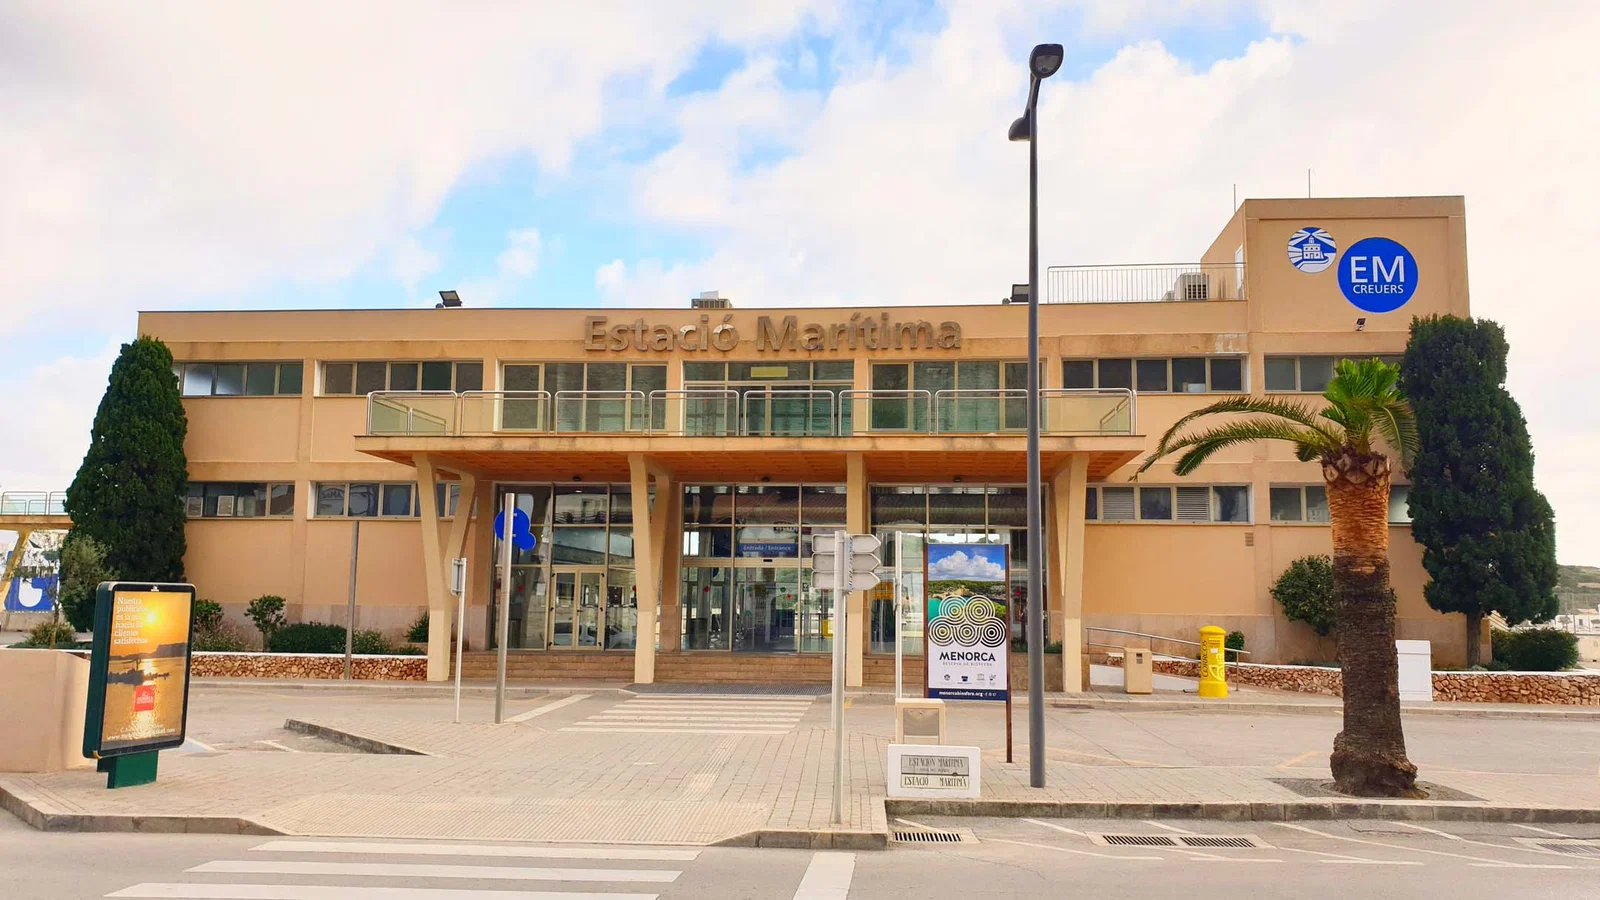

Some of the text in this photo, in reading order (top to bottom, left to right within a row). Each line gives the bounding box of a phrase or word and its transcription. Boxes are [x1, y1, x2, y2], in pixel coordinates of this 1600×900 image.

[1350, 255, 1405, 283] EM
[1352, 284, 1404, 294] CREUERS
[584, 312, 962, 352] Estació Marítima
[939, 651, 996, 662] MENORCA
